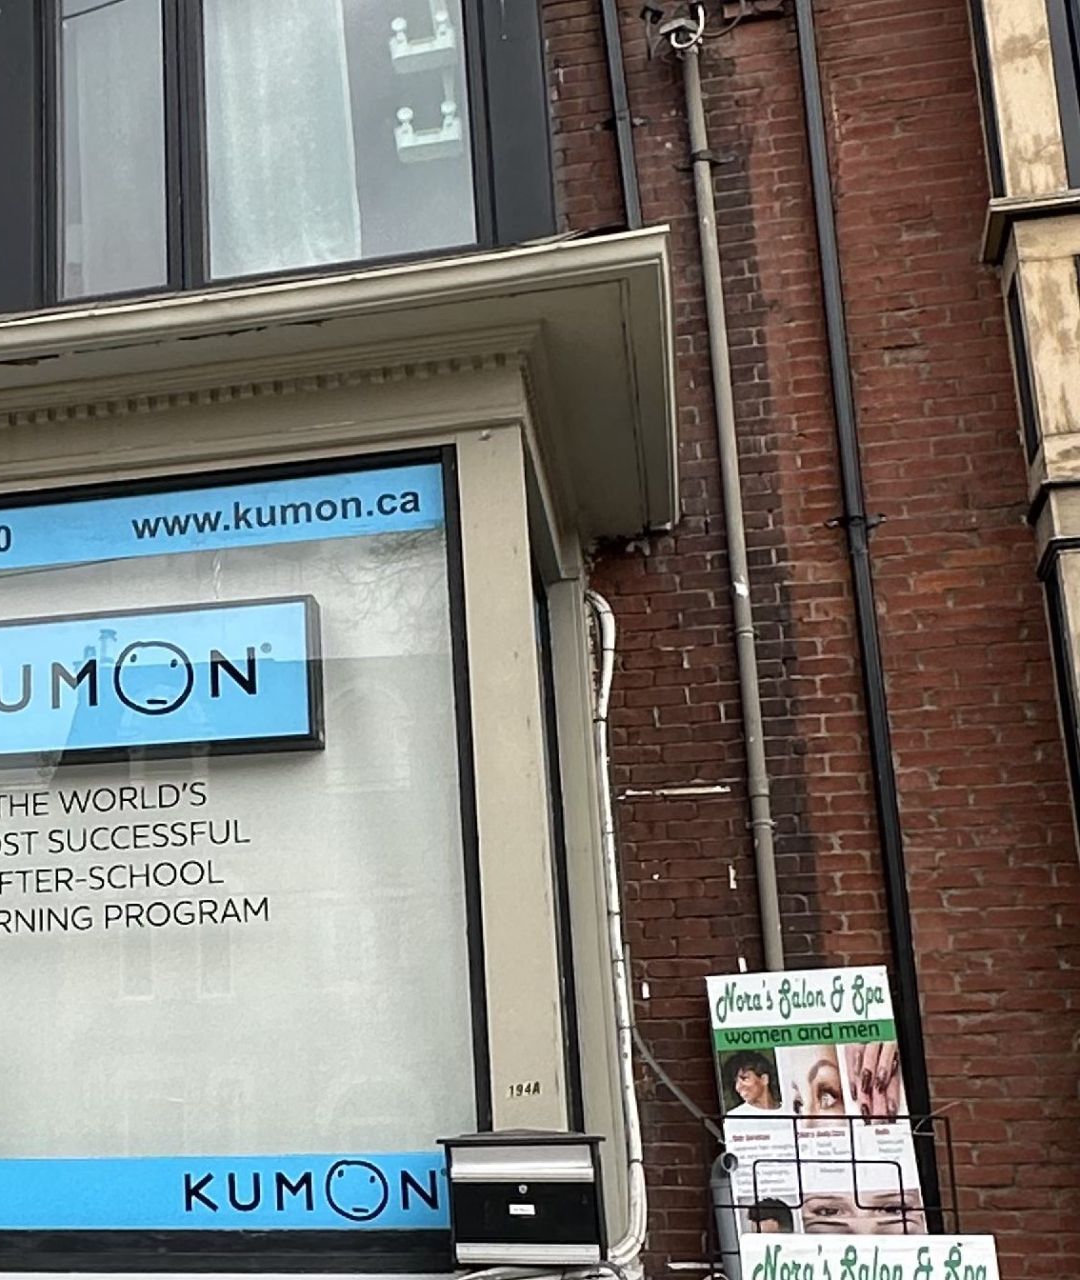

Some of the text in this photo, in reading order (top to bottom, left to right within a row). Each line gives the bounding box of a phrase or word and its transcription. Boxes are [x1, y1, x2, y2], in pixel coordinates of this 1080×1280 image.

[132, 488, 421, 540] www.kumon.ca
[60, 782, 208, 815] WORLD'S
[48, 820, 251, 856] SUCCESSFUL
[104, 896, 269, 932] PROGRAM
[716, 980, 773, 1023] Nora's
[778, 978, 826, 1020] Salon
[851, 974, 885, 1019] Spa
[725, 1022, 880, 1045] women and men
[509, 1081, 541, 1098] 194A
[184, 1159, 440, 1222] KUMON
